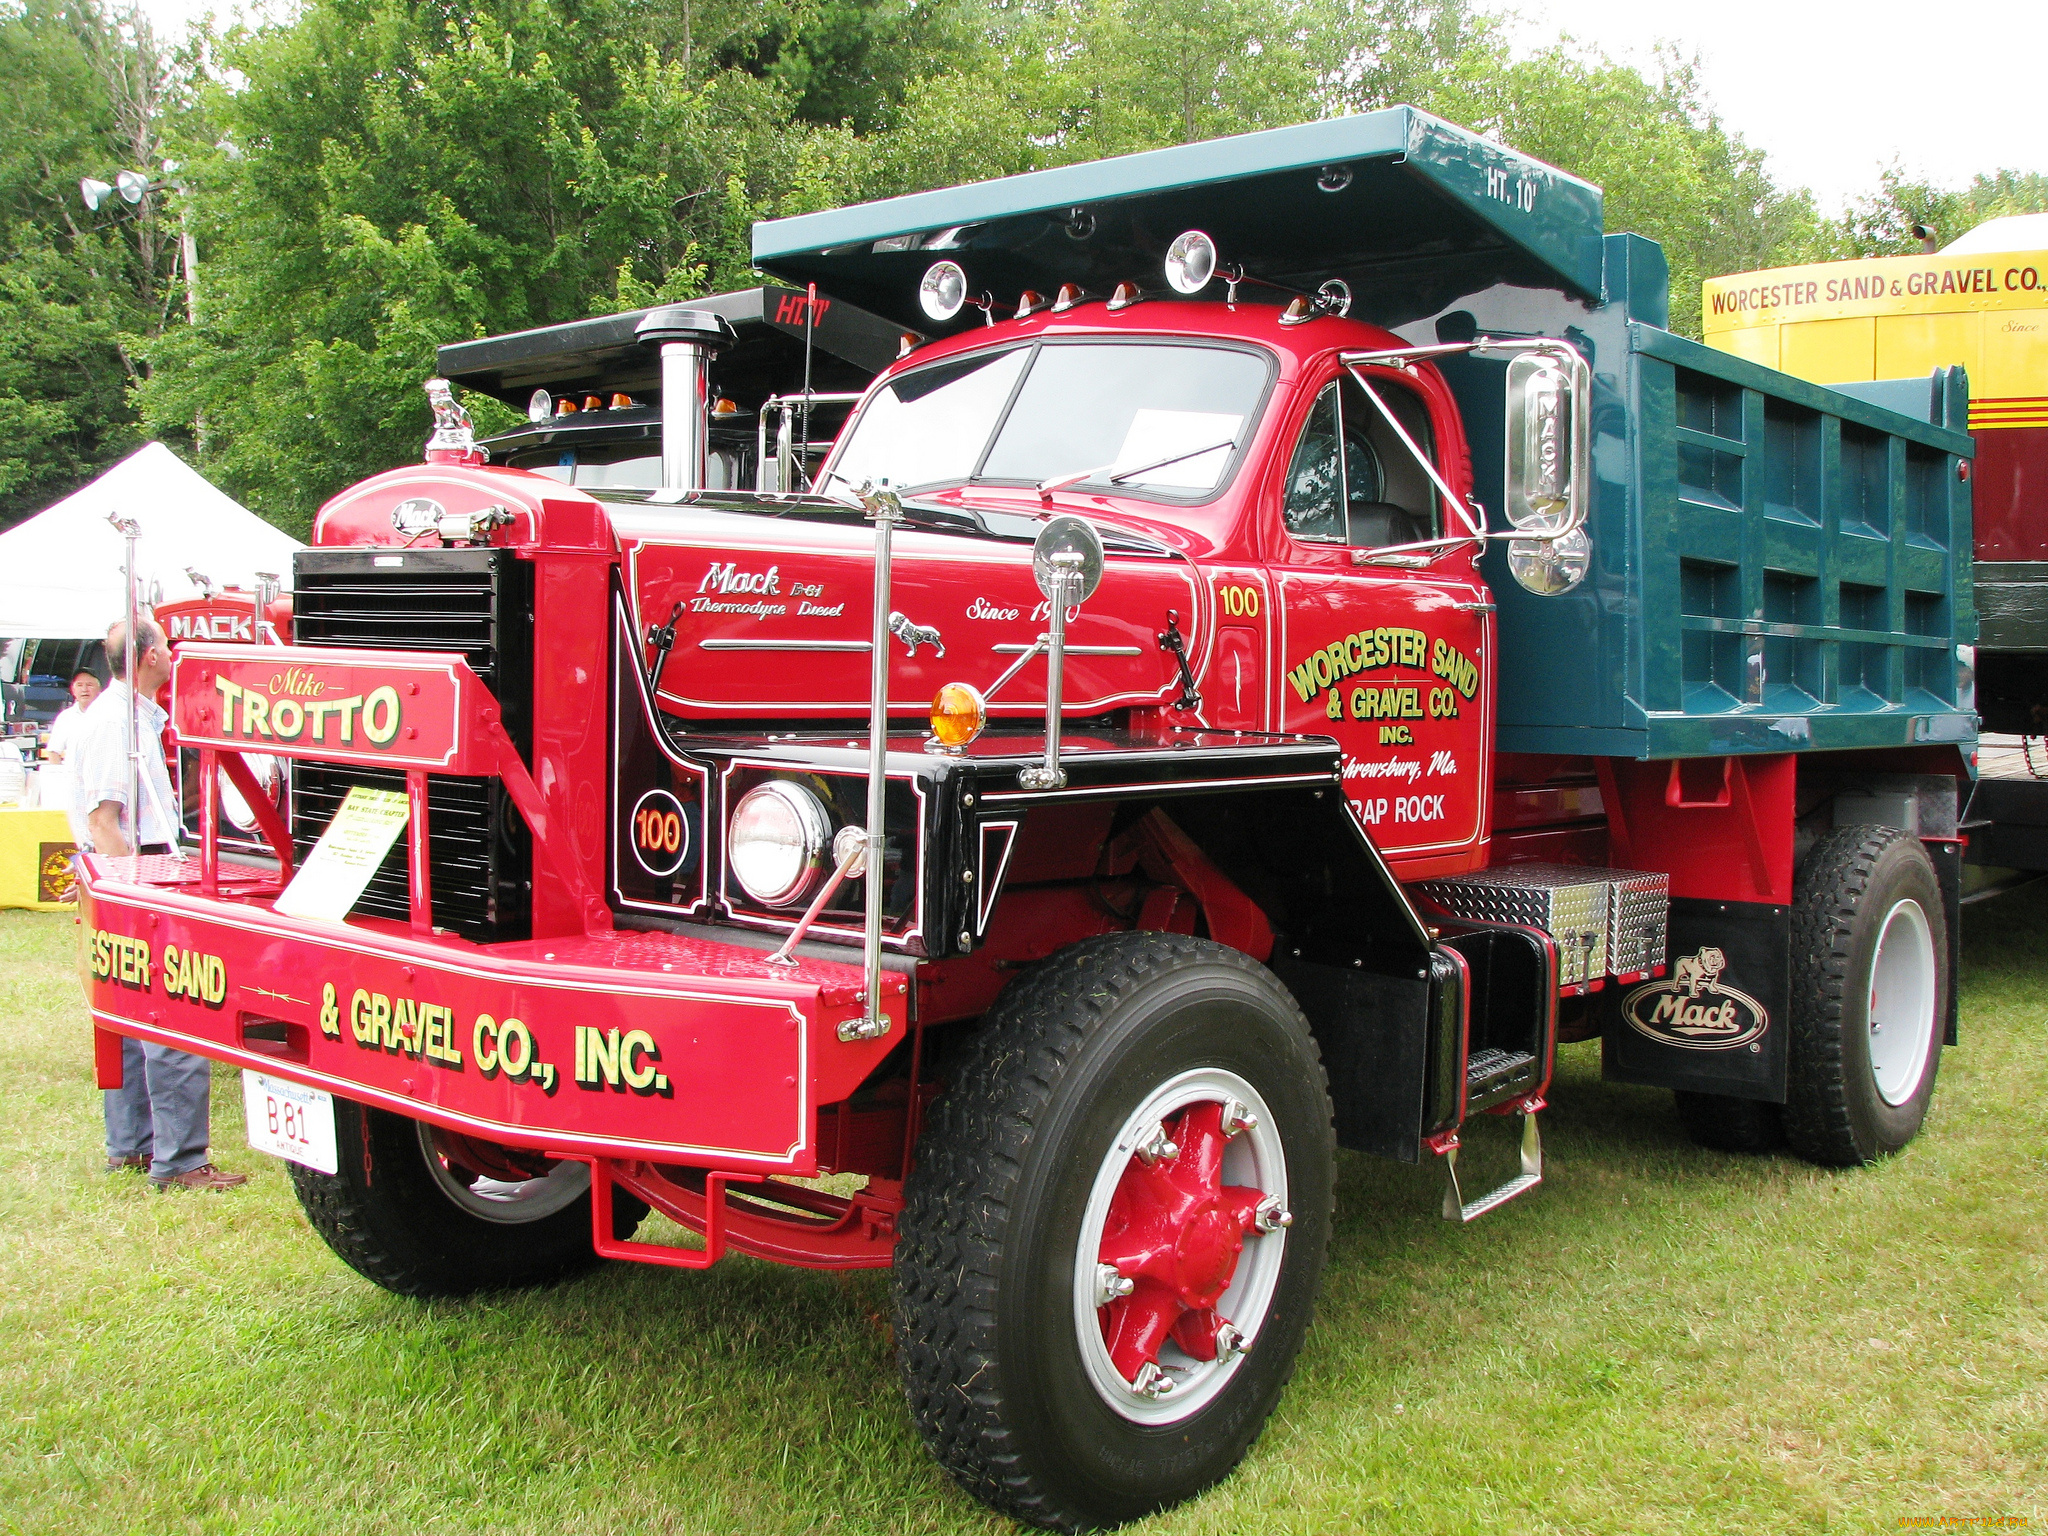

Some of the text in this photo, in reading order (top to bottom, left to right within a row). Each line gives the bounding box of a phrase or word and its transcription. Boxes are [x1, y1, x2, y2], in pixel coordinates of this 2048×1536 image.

[1487, 166, 1537, 213] HT. 10'
[1712, 281, 1818, 315] WORCESTER
[1826, 274, 1885, 301] SAND
[1890, 279, 1904, 296] &
[1907, 268, 2000, 296] GRAVEL
[2001, 319, 2040, 333] Since
[1539, 395, 1558, 486] MACK
[696, 562, 781, 596] Mack
[690, 597, 845, 621] Thermodyne Diesel
[965, 596, 1080, 623] Since 190
[1219, 585, 1259, 618] 100
[170, 615, 252, 640] MACK
[1287, 627, 1480, 703] WORCESTER SAND
[269, 667, 325, 697] Mike
[215, 673, 401, 746] TROTTO
[1325, 687, 1459, 719] & GRAVEL CO.
[1378, 726, 1414, 745] INC.
[1427, 750, 1458, 777] Ma.
[1349, 794, 1446, 825] RAP ROCK
[636, 808, 682, 854] 100
[163, 944, 227, 1006] SAND
[320, 982, 342, 1038] &
[350, 988, 463, 1066] GRAVEL
[473, 1013, 557, 1091] CO.,
[575, 1025, 670, 1092] INC.
[1649, 994, 1740, 1035] Mack
[264, 1078, 312, 1105] Massachusetts
[267, 1095, 309, 1144] B 81
